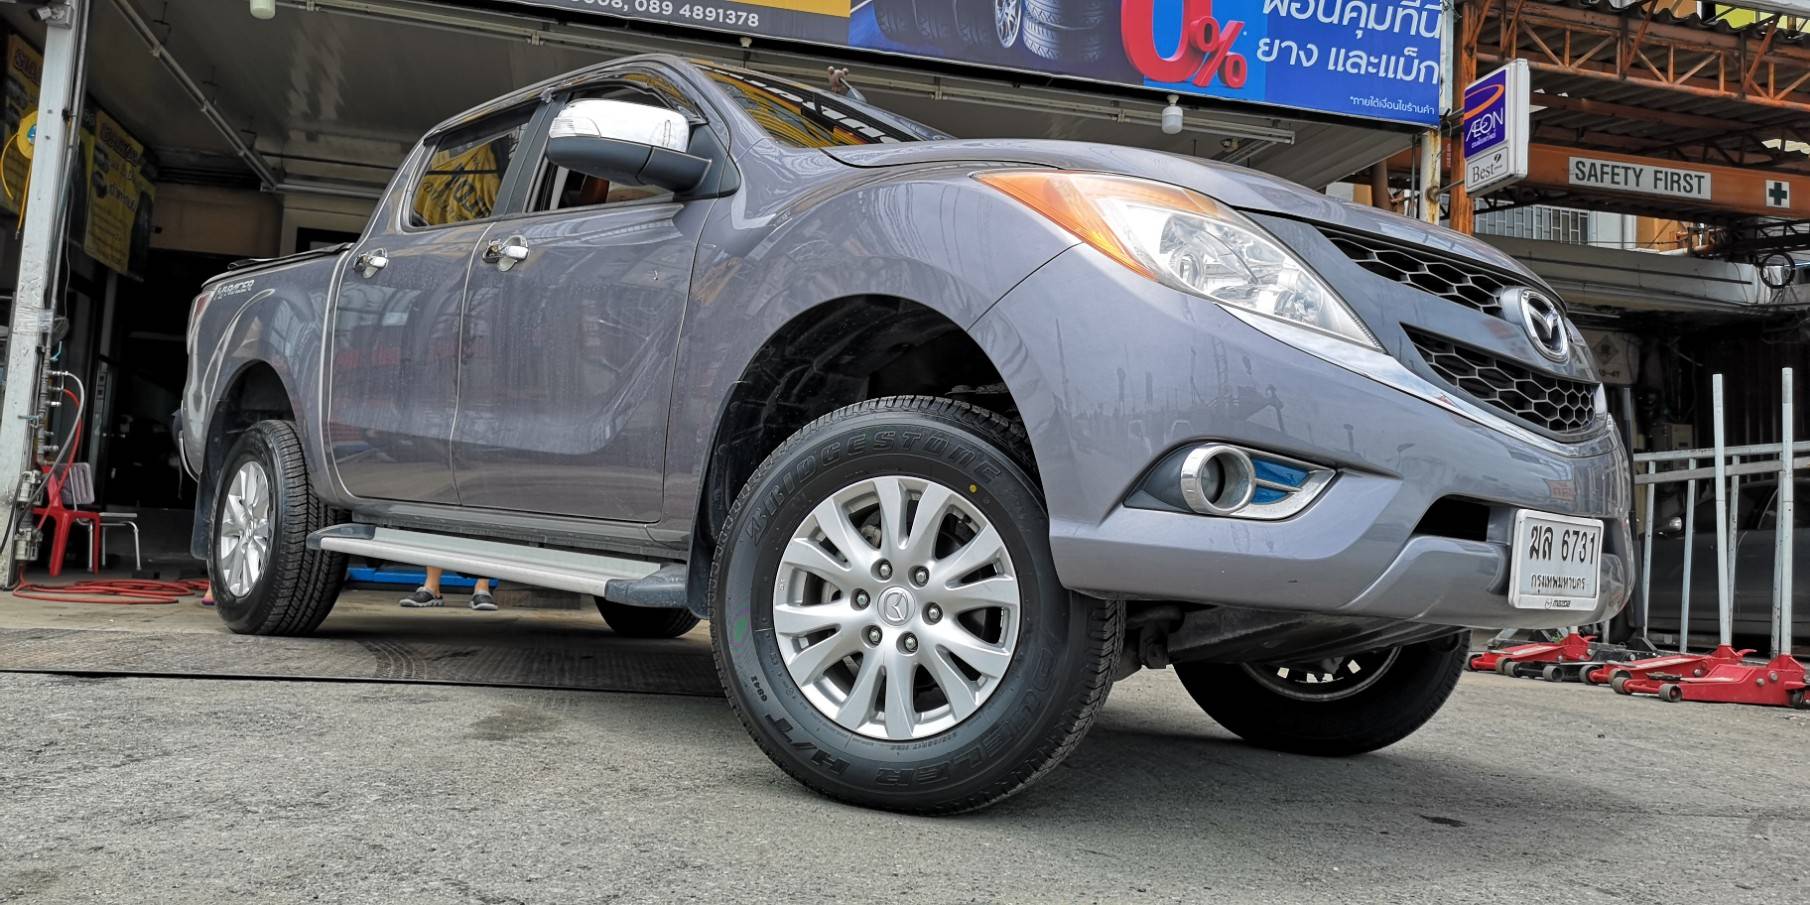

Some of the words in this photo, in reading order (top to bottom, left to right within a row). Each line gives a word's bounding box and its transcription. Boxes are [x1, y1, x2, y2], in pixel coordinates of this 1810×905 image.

[634, 0, 673, 15] 089
[679, 4, 759, 27] 4891378
[1256, 38, 1319, 68] ยาง
[1327, 47, 1440, 85] และแม็ก
[1472, 163, 1494, 183] Best
[1575, 160, 1643, 187] SAFETY
[1653, 169, 1705, 195] FIRST
[746, 428, 1001, 546] BRIDGESTONE
[1561, 529, 1596, 564] 6731
[1530, 575, 1585, 594] กรุงเทพมหานคร
[762, 711, 852, 778] H/T
